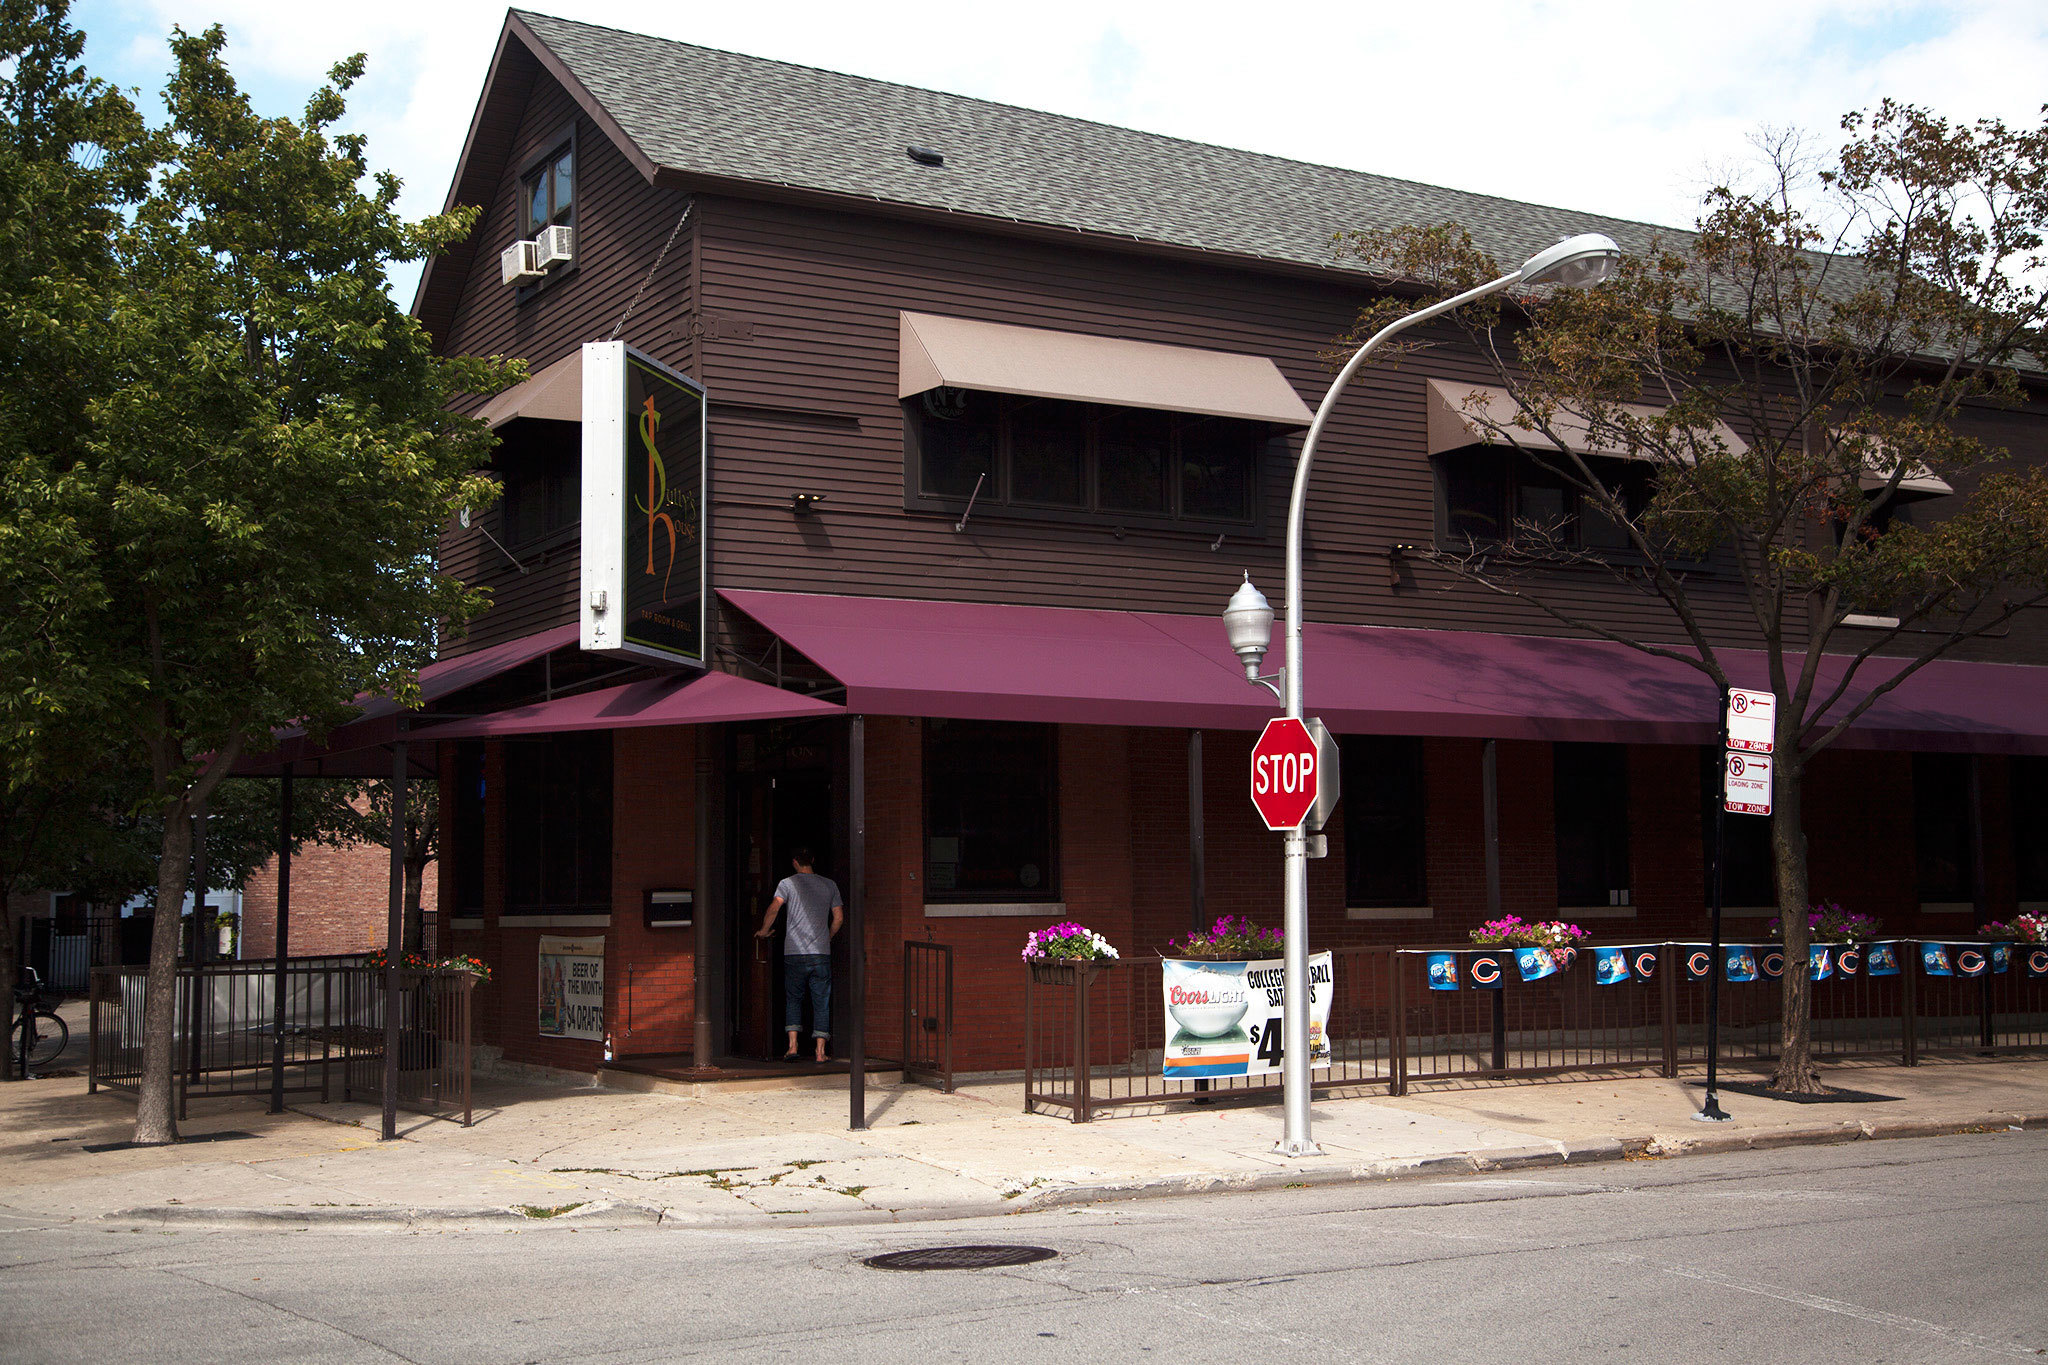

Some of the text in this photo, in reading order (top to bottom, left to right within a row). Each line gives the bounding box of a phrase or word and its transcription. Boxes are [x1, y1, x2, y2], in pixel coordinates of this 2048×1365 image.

[654, 613, 671, 625] ROOM
[1729, 739, 1769, 751] TOW ZONE
[1256, 752, 1314, 795] STOP
[1728, 780, 1764, 790] LOADING ZONE
[1728, 802, 1767, 814] TOW ZONE
[573, 963, 599, 978] BEER OF
[568, 979, 603, 996] THE MONTH
[1169, 985, 1245, 1005] Coors LIGHT
[567, 1003, 603, 1032] $4 DRAFTS
